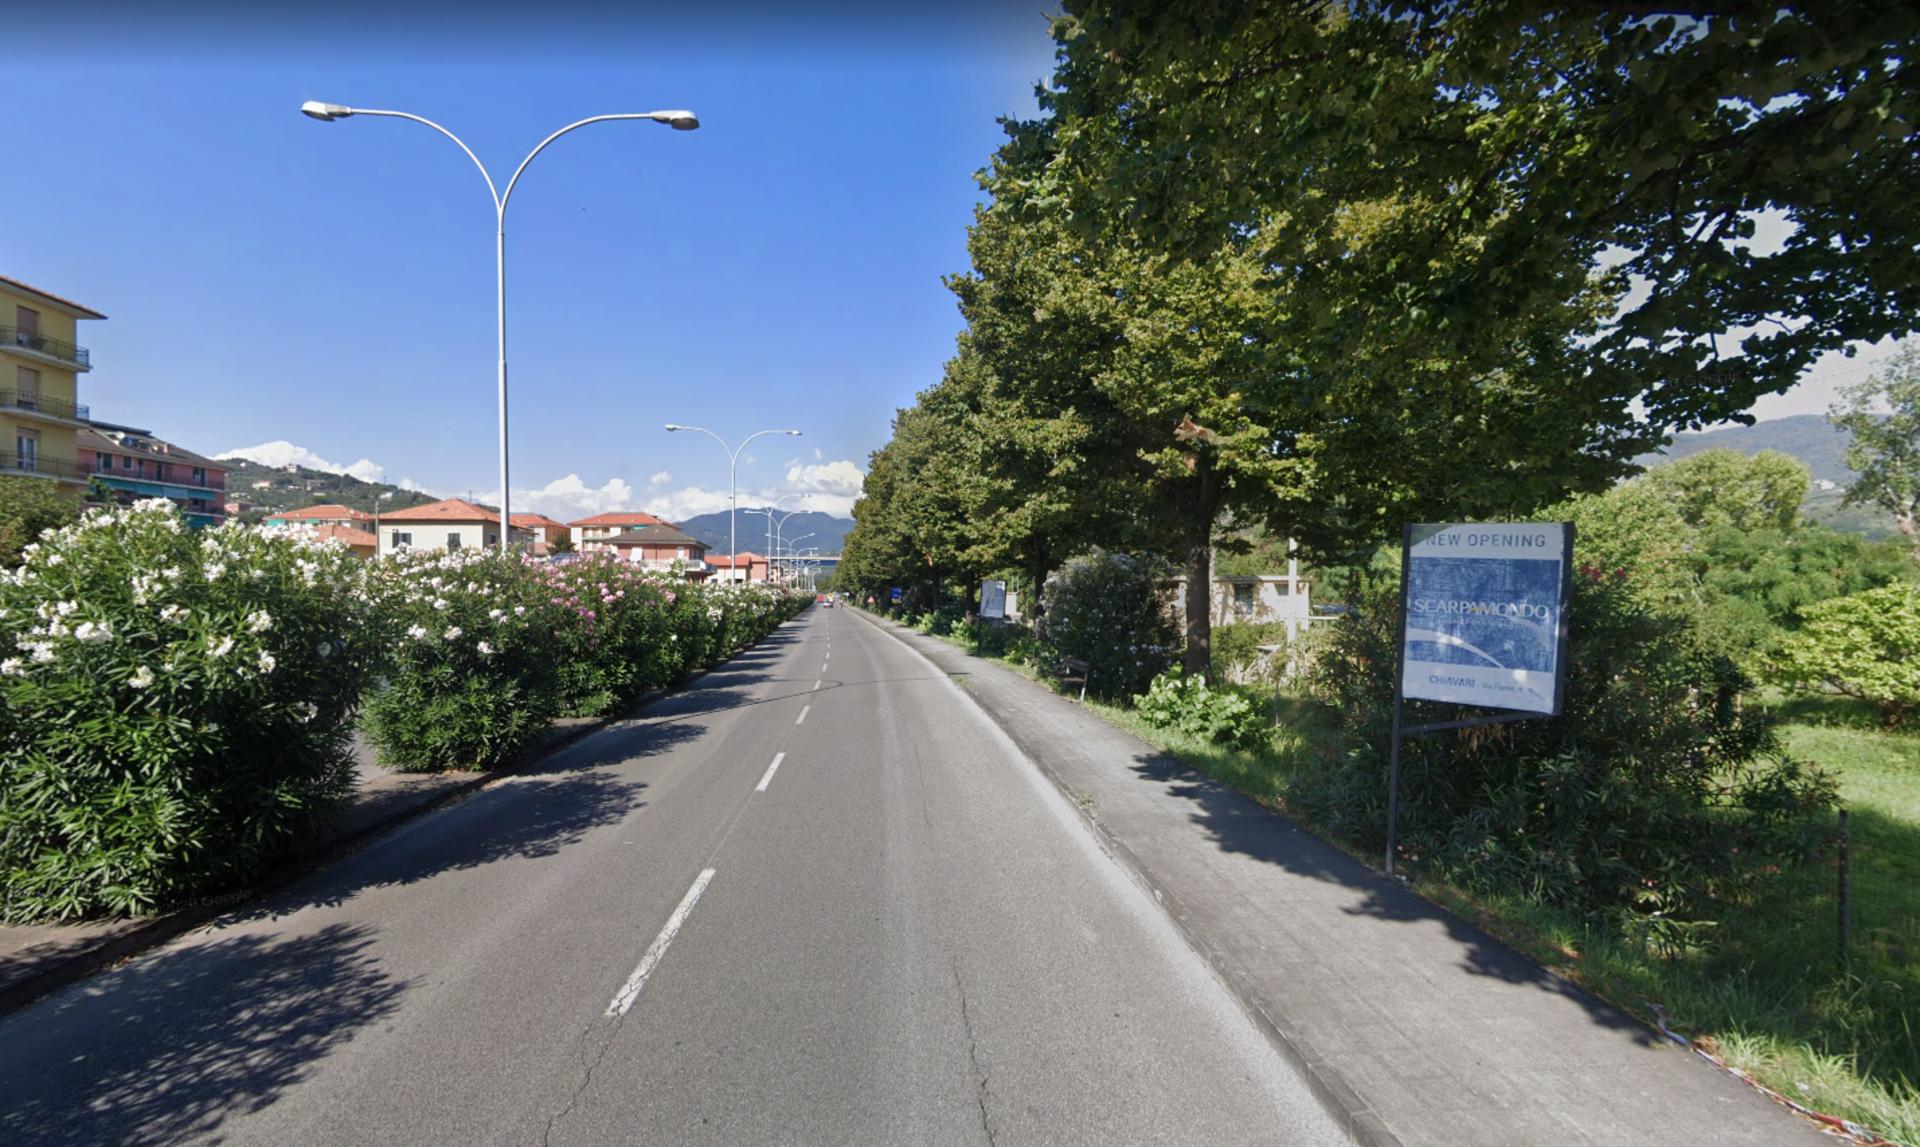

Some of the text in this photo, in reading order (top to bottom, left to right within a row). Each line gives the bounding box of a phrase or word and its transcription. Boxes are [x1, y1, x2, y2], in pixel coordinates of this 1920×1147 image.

[1425, 534, 1546, 548] NEW OPENING
[1414, 599, 1549, 619] SCARPAMONDO
[1429, 675, 1475, 688] CHIAVARI
